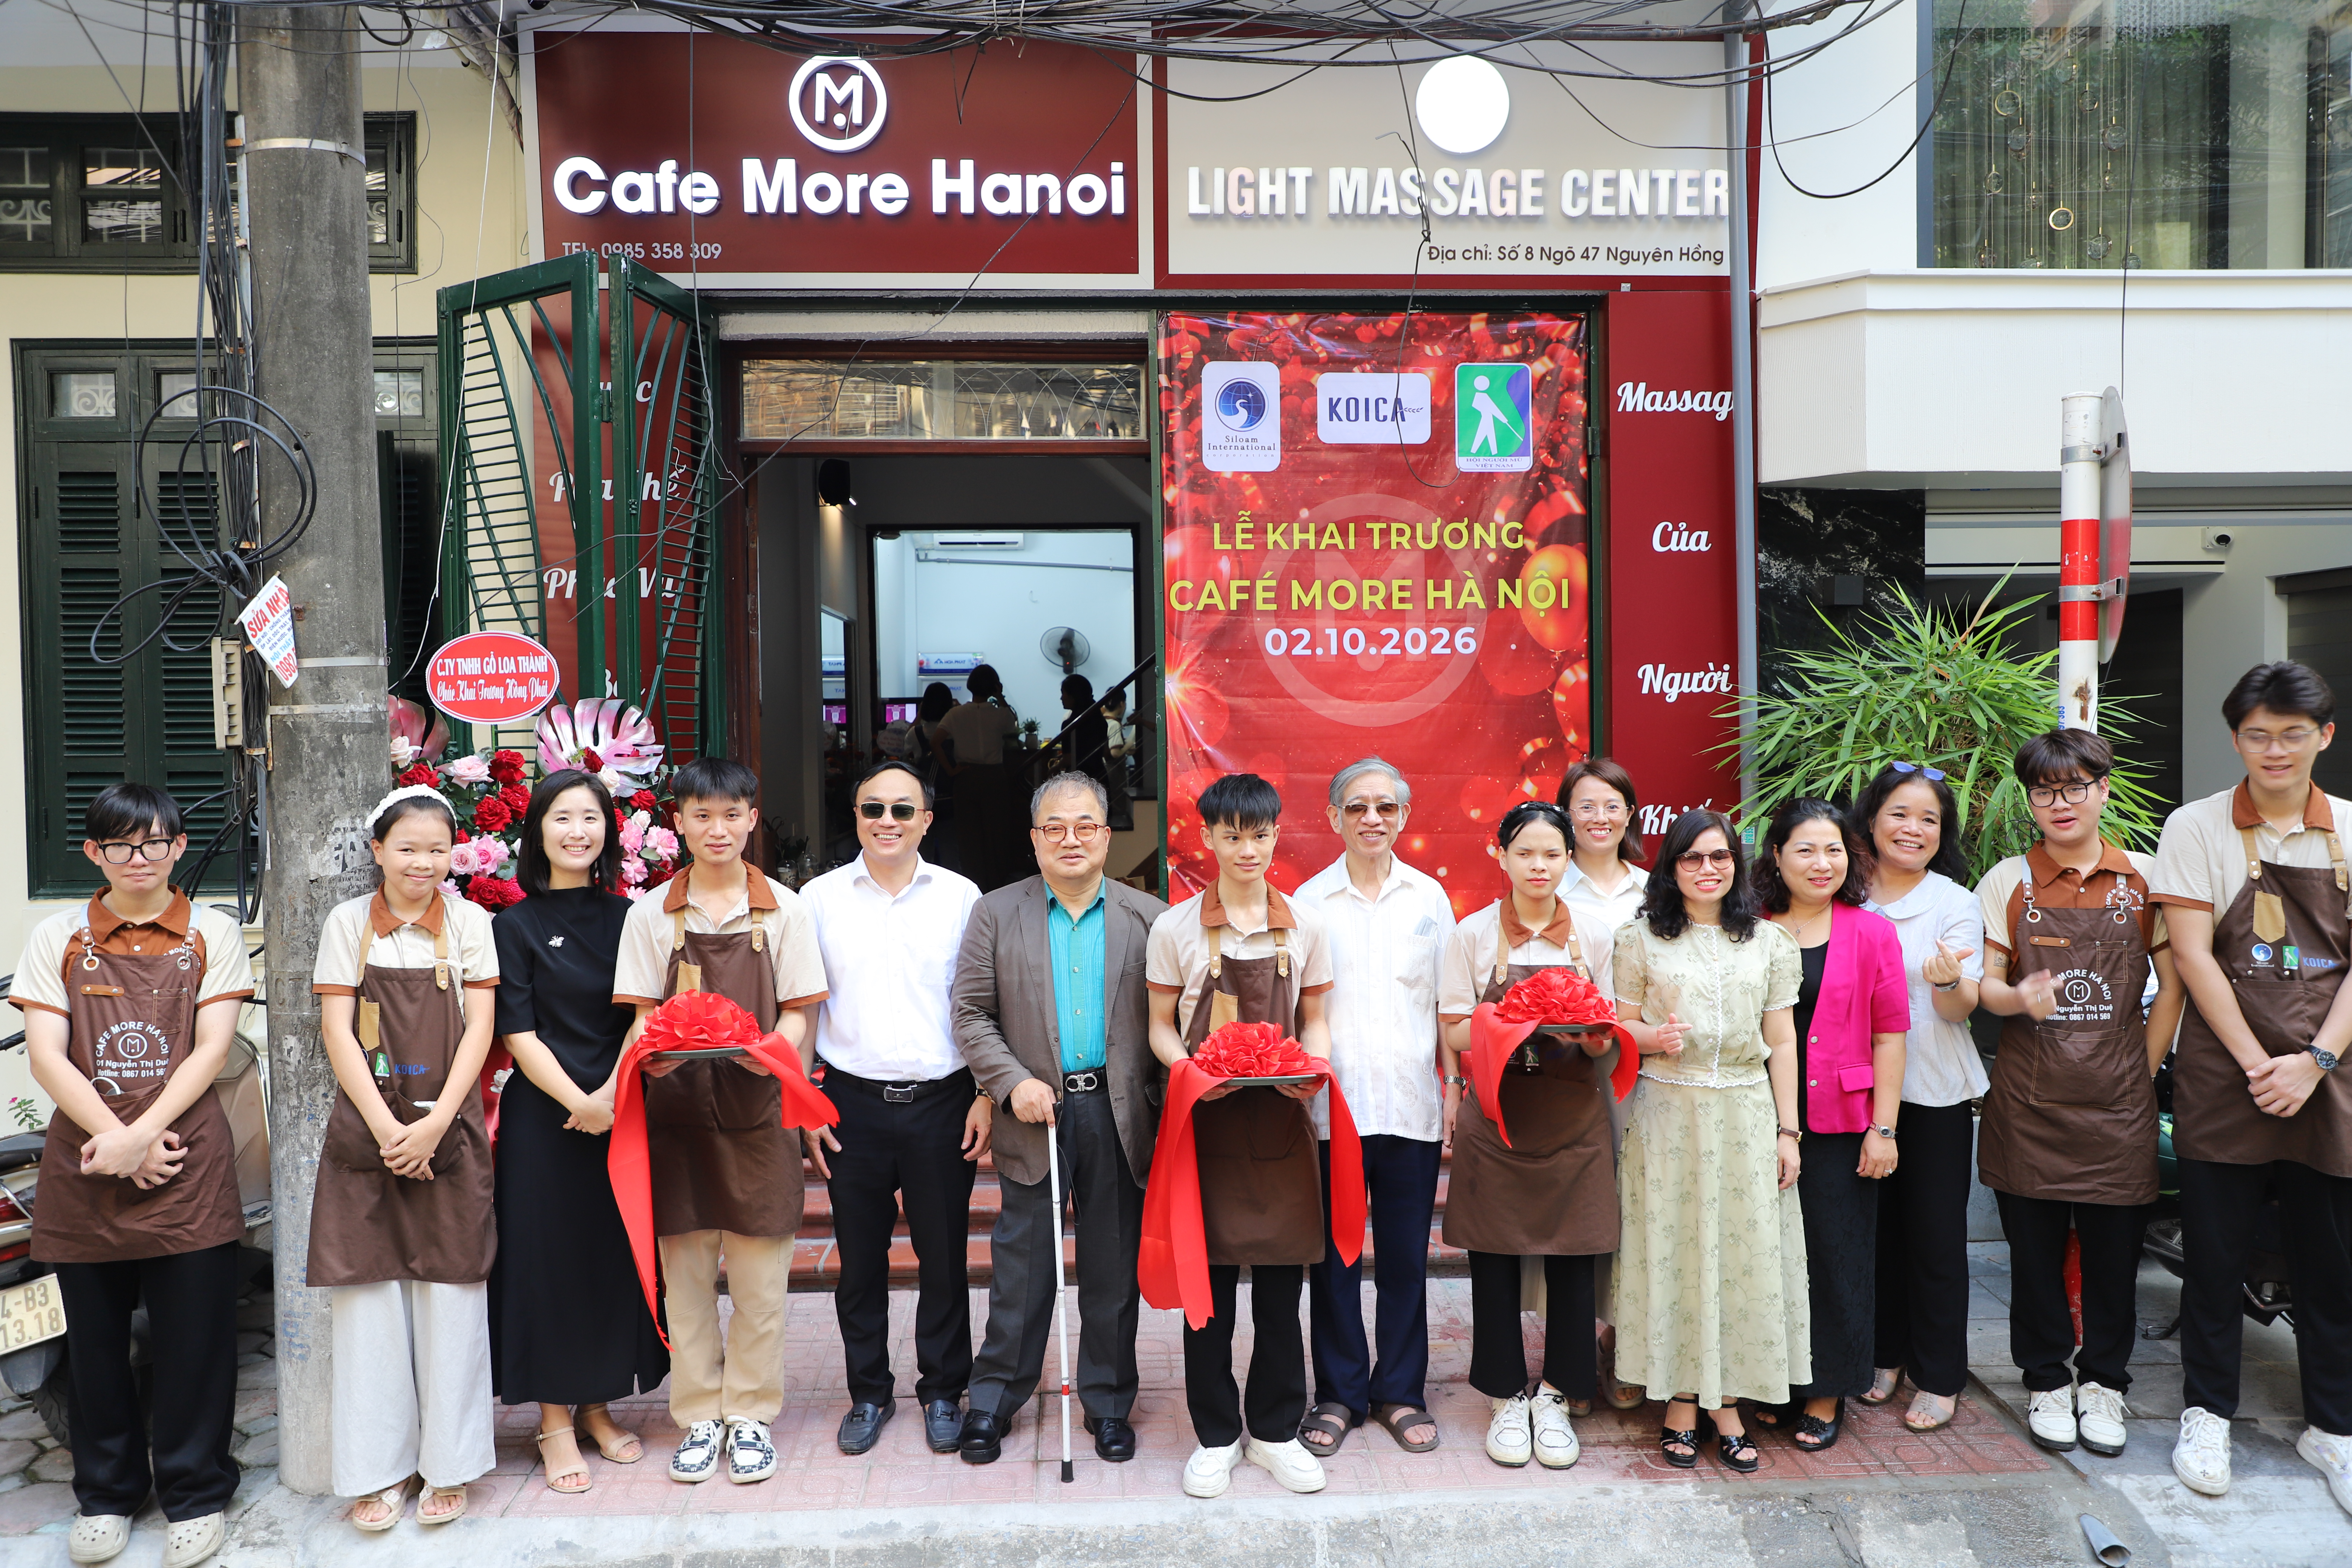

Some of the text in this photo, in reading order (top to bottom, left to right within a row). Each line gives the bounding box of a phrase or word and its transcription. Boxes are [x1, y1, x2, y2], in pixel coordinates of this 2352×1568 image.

[553, 156, 1125, 216] Cafe More Hanoi
[1187, 166, 1729, 217] LIGHT MASSAGE CENTER
[651, 243, 683, 259] 358
[689, 243, 722, 259] 309
[1427, 244, 1724, 265] Địa chỉ: Số 8 Ngõ 47 Nguyên Hồng
[1329, 397, 1406, 422] KOICA
[1617, 381, 1734, 421] Massag
[1213, 510, 1524, 550] LỄ KHAI TRƯƠNG
[1652, 521, 1712, 553] Của
[1169, 571, 1569, 617] CAFÉ MORE HÀ NỘI
[247, 609, 270, 638] SỬA
[1264, 627, 1477, 656] 02.10.2026
[456, 657, 481, 675] TNHH
[483, 651, 496, 675] GỖ
[498, 656, 517, 674] LOA
[517, 652, 548, 673] THÀNH
[436, 680, 456, 702] Chúc
[456, 680, 477, 701] Khai
[528, 677, 548, 702] Phát
[1637, 662, 1733, 703] Người
[2303, 957, 2333, 968] KOICA
[2056, 969, 2088, 981] MORE
[2089, 971, 2103, 985] HA
[2055, 1004, 2083, 1013] Nguyễn
[95, 1031, 112, 1057] CAFE
[110, 1021, 144, 1035] MORE
[145, 1024, 161, 1038] HA
[98, 1069, 120, 1077] Hotline:
[156, 1068, 166, 1076] 56
[105, 1060, 138, 1069] Nguyễn
[139, 1060, 154, 1069] Thị
[395, 1064, 426, 1075] KOICA
